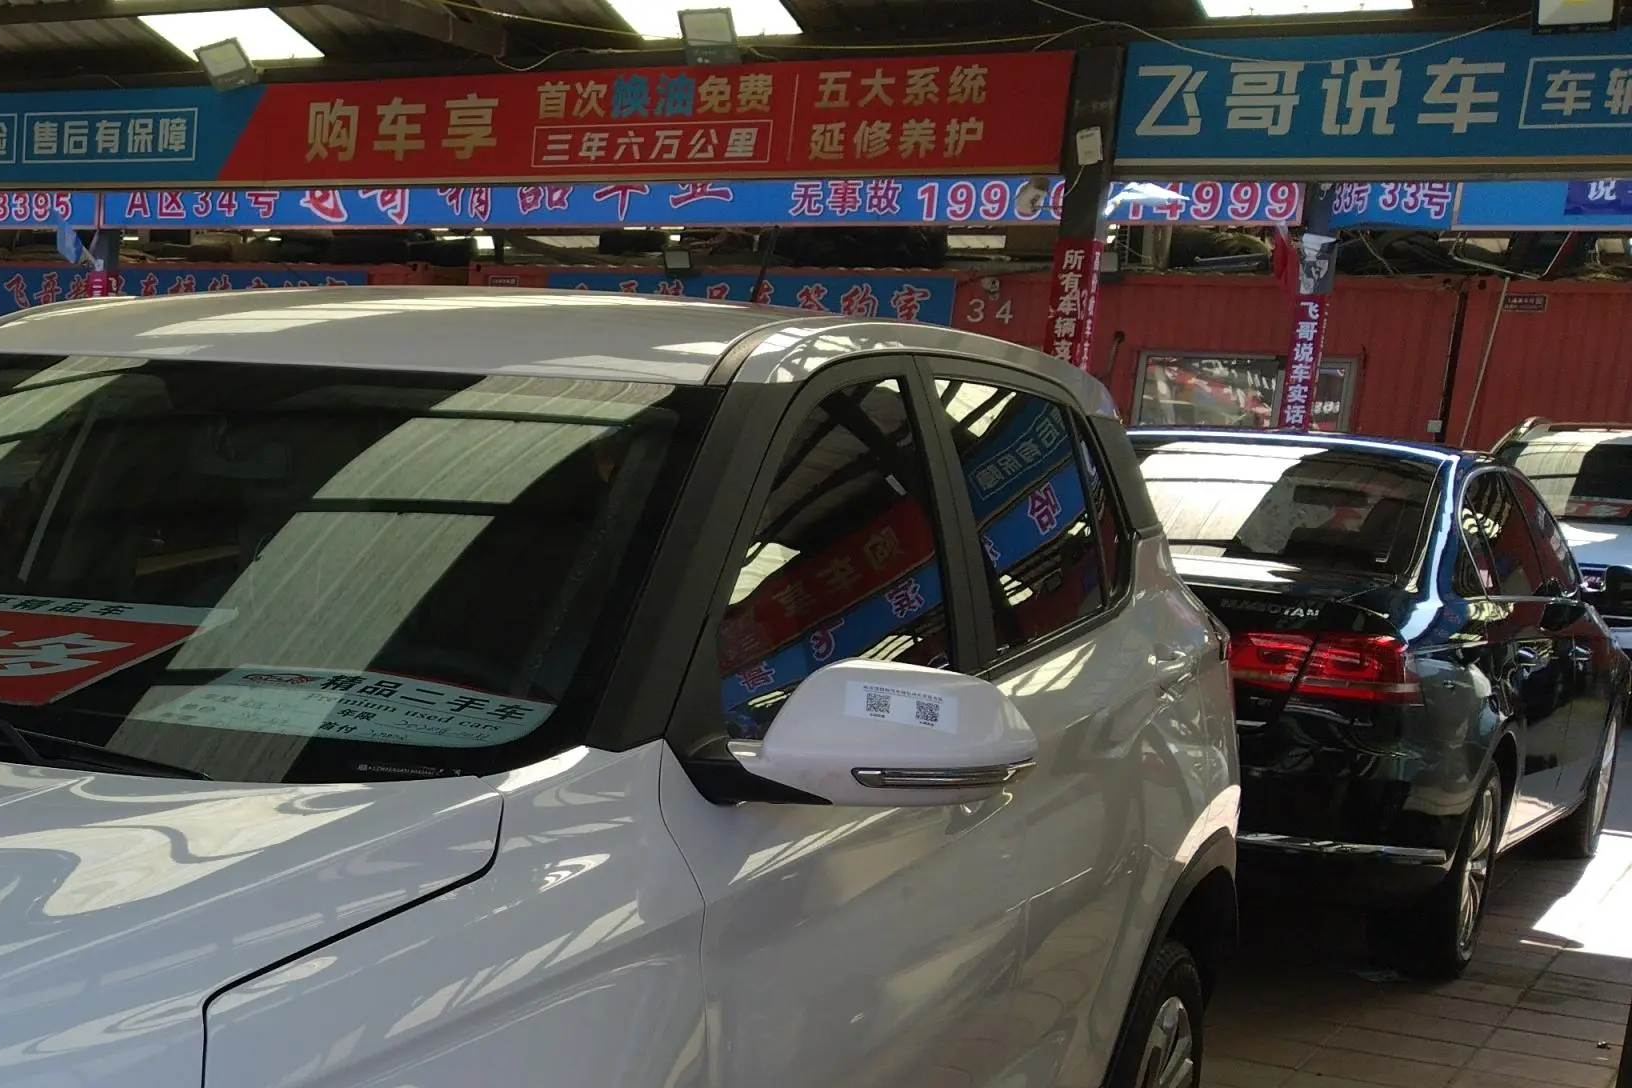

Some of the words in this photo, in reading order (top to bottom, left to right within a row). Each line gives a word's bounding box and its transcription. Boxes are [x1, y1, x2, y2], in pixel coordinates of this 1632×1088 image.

[537, 73, 773, 120] 首次换油免费
[814, 65, 988, 109] 五大系统
[1135, 57, 1505, 136] 飞哥说车
[31, 110, 189, 156] 售后有保障
[305, 93, 500, 163] 购车享
[542, 127, 758, 162] 三年六万公里
[809, 117, 985, 160] 延修养护
[790, 179, 902, 217] 无事故
[966, 299, 1014, 325] 34
[1283, 302, 1320, 430] 飞哥说车实话
[320, 674, 536, 721] 精品二手车
[404, 709, 454, 724] used
[458, 718, 502, 732] cars
